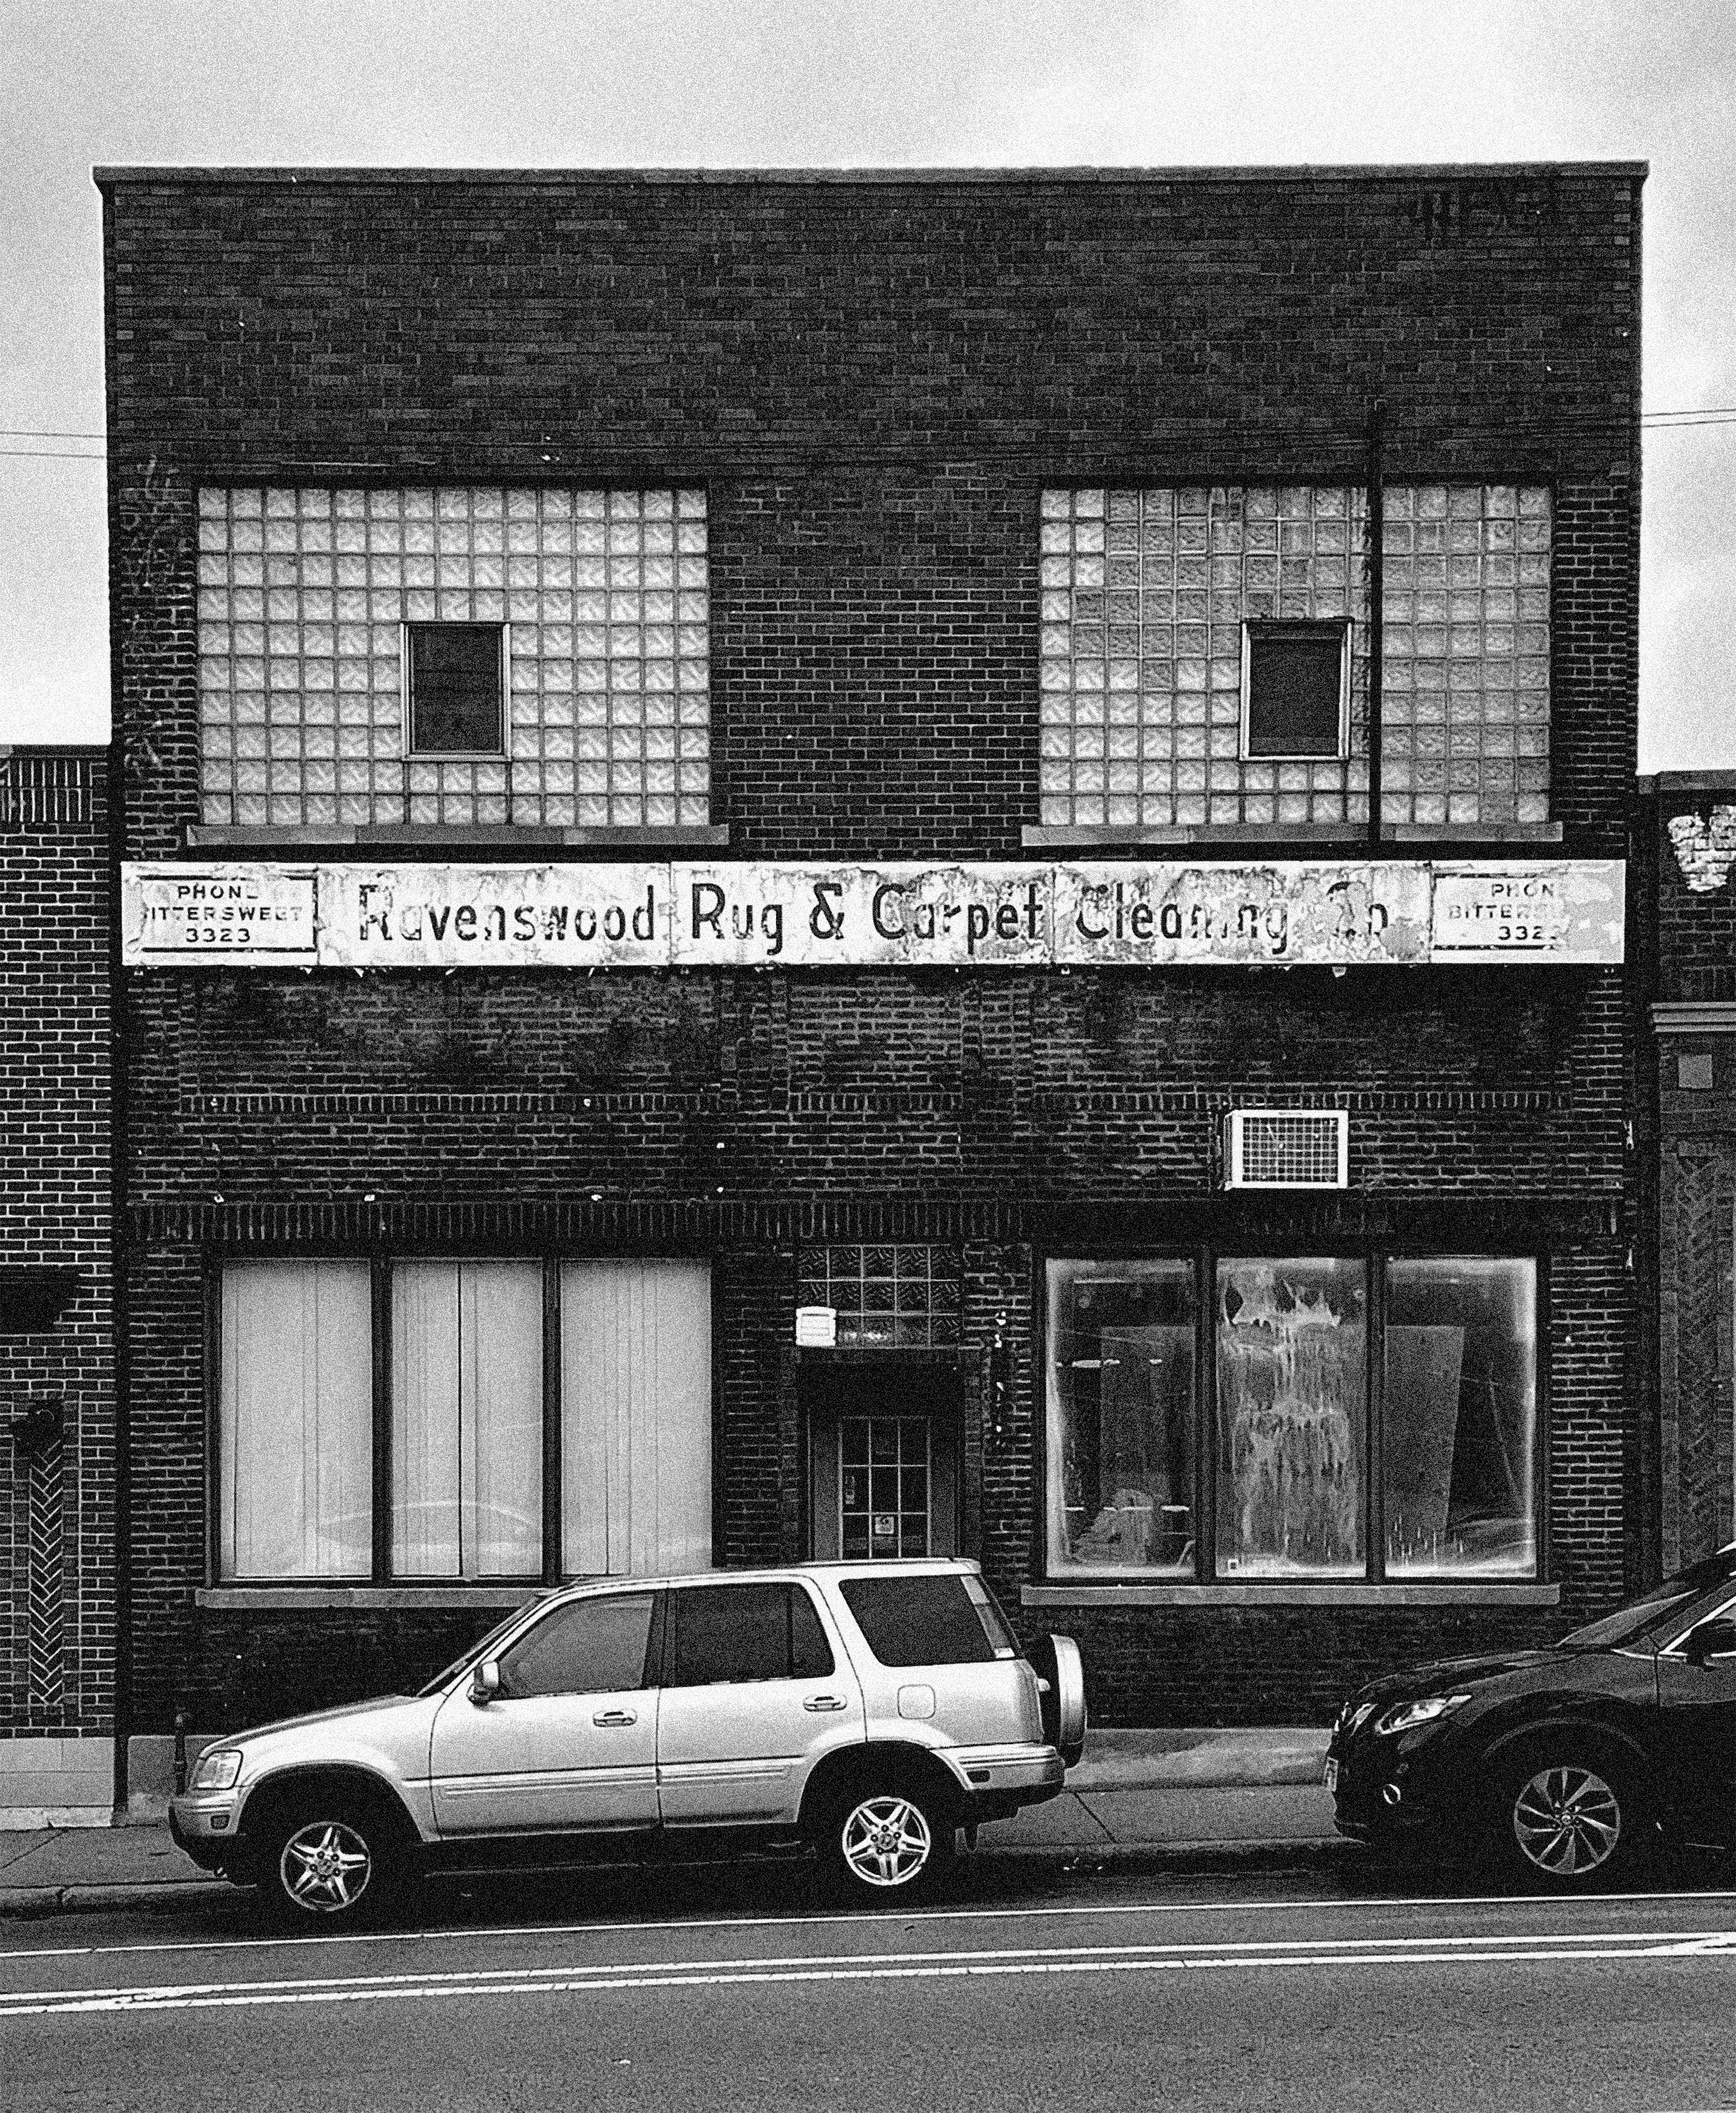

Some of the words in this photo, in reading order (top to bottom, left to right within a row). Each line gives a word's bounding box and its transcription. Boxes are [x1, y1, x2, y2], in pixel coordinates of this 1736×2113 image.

[143, 906, 302, 922] ITTERSWEET
[359, 884, 655, 941] Ravenswood
[692, 882, 783, 956] Rug
[809, 883, 844, 941] &
[872, 883, 1043, 956] Carpet
[1076, 881, 1288, 955] Cleanng
[185, 927, 251, 944] 3323
